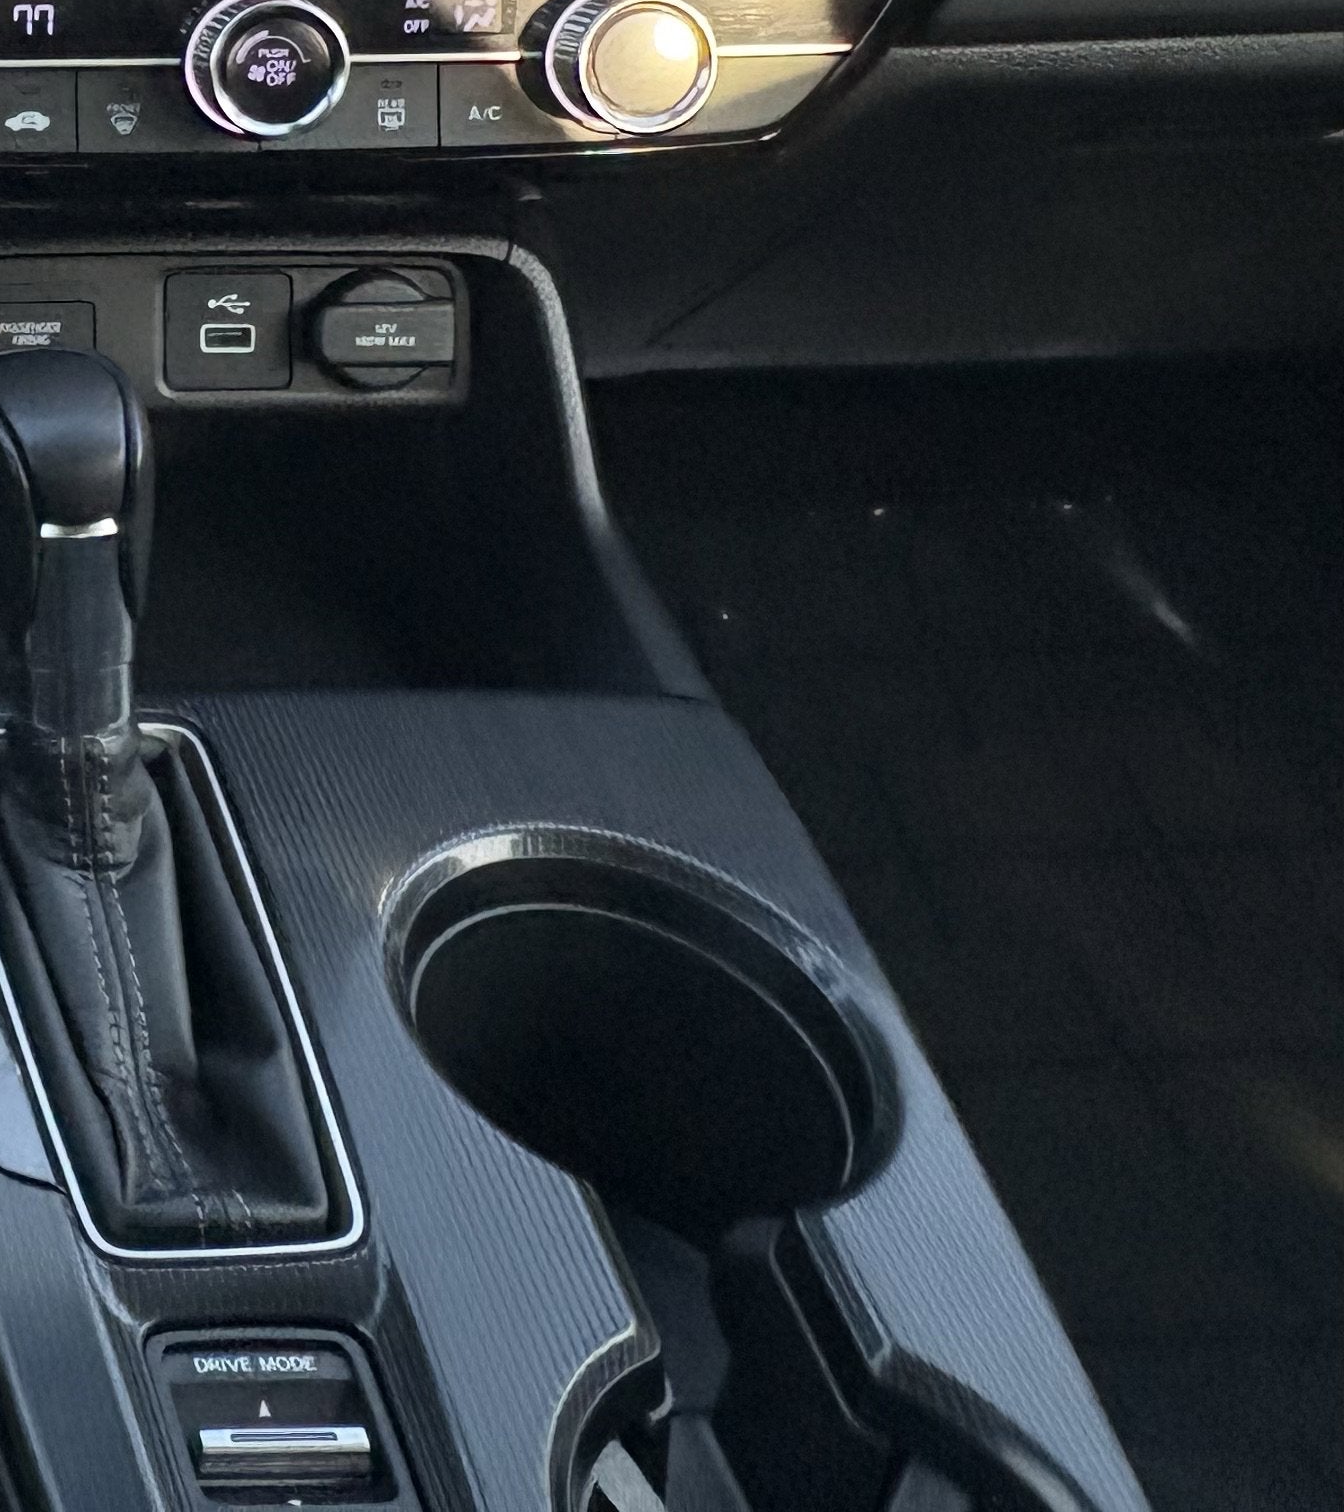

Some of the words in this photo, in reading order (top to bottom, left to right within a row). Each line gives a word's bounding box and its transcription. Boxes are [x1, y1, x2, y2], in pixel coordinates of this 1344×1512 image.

[13, 4, 54, 35] 77
[266, 71, 297, 86] OFF
[468, 105, 503, 121] A/C
[193, 1355, 252, 1374] DRIVE
[259, 1355, 318, 1373] MODE
